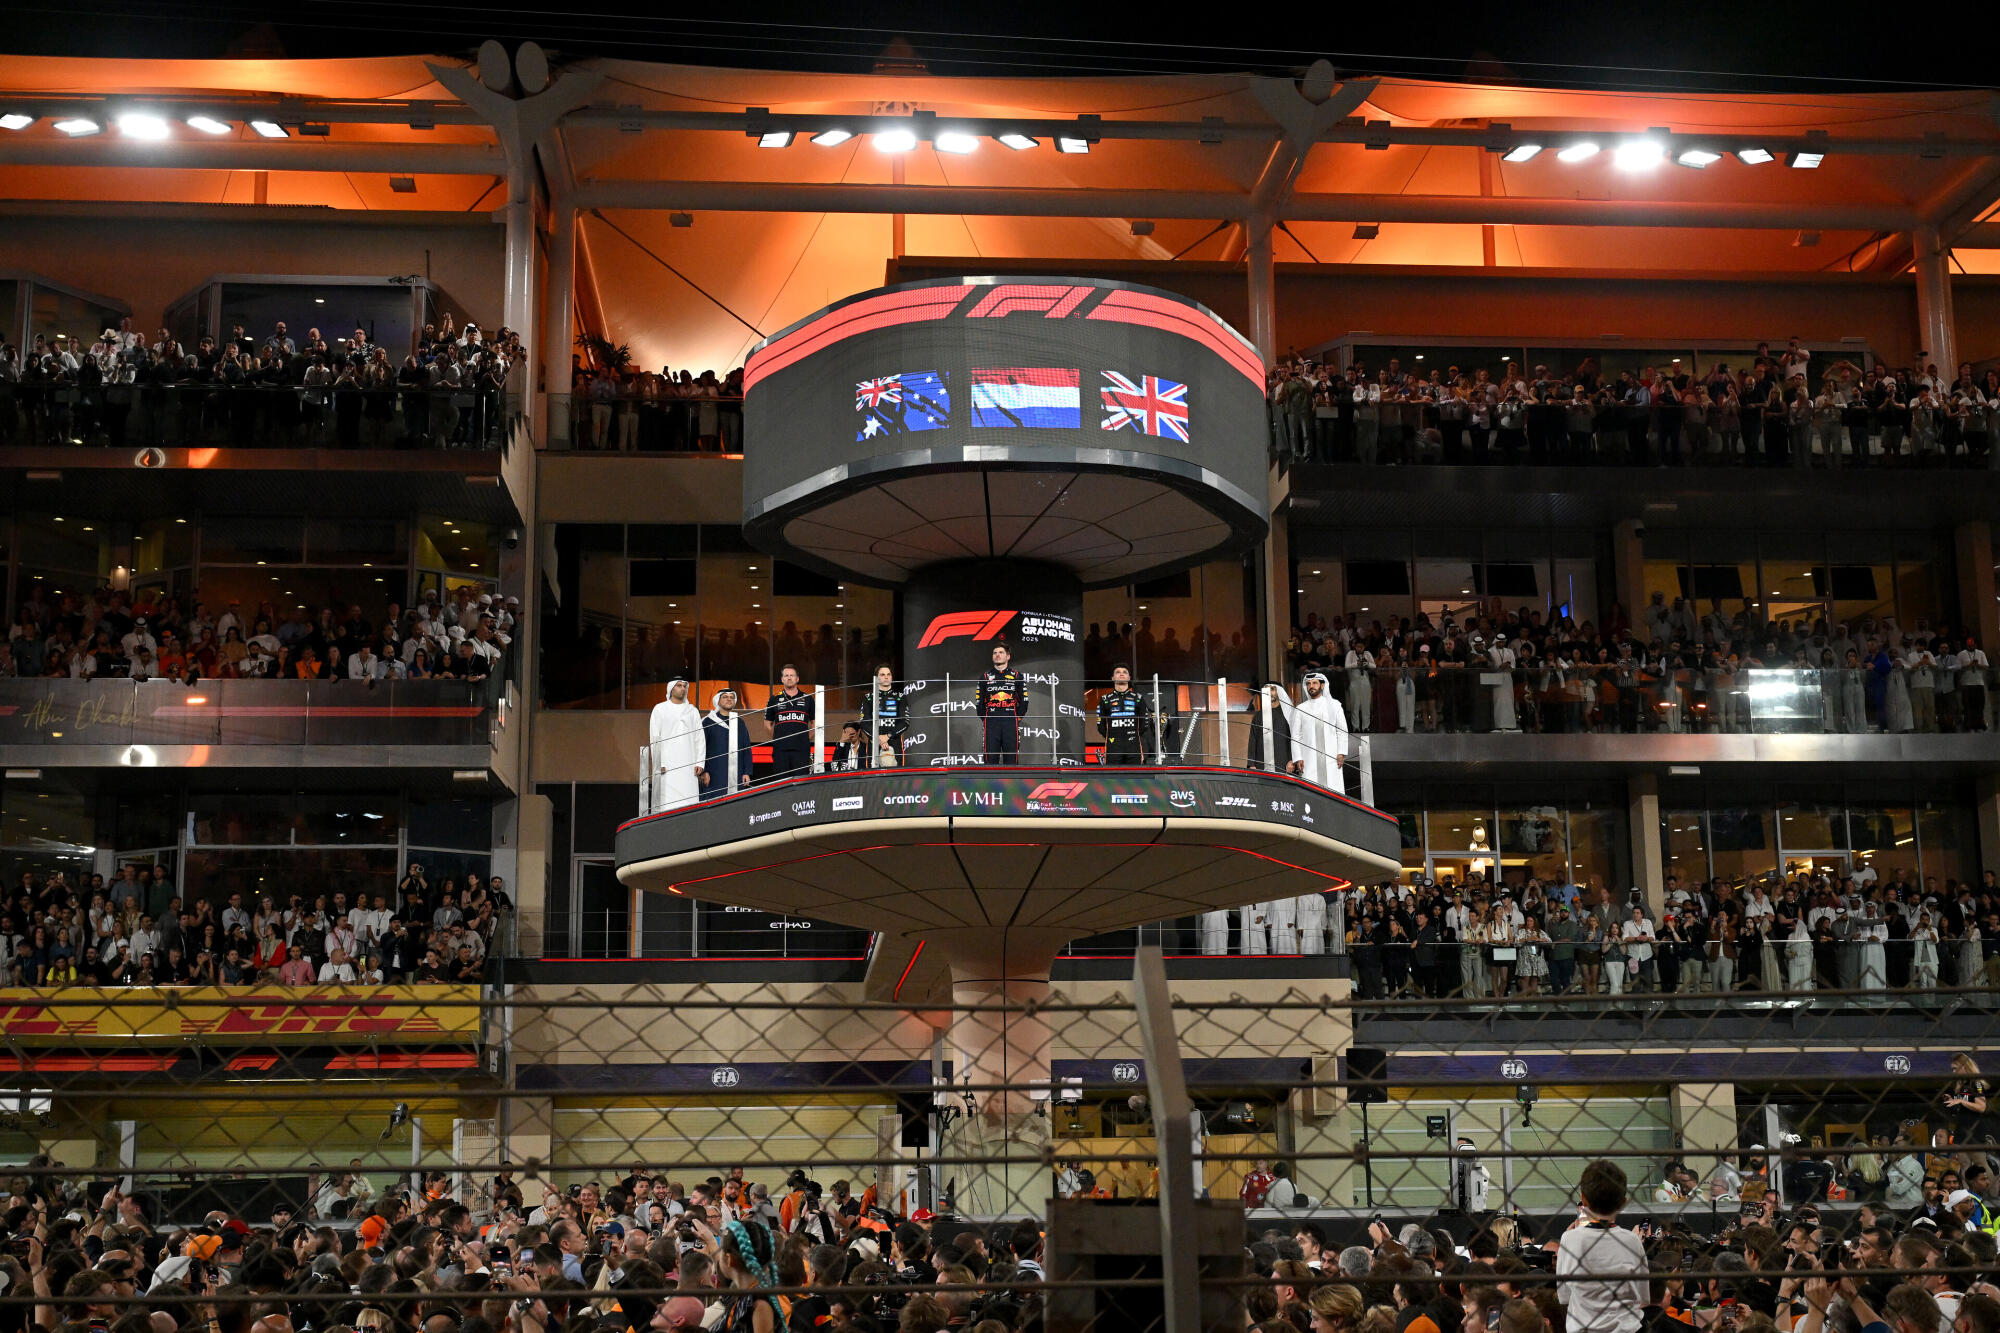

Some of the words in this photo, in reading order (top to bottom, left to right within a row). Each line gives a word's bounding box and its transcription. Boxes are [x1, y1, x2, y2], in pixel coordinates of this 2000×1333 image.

[1022, 617, 1045, 627] ABU
[1045, 619, 1071, 632] DHABI
[1021, 626, 1058, 638] GRAND
[1058, 630, 1075, 642] PRIX
[22, 692, 67, 730] Abu
[74, 694, 141, 730] Dhabi
[930, 701, 976, 714] ETIHA
[778, 713, 791, 722] Red
[791, 712, 805, 721] Bull
[878, 719, 895, 727] KX
[1111, 718, 1135, 728] OKX
[883, 794, 929, 805] aramco
[952, 792, 1004, 805] LVMH
[1111, 794, 1148, 804] PIRELLI
[1170, 790, 1195, 801] aws
[792, 800, 816, 811] QATAR
[835, 800, 860, 808] Lenovo
[1221, 796, 1251, 807] DHL
[1280, 801, 1295, 813] MSC
[755, 810, 782, 822] crypto.com
[216, 995, 405, 1033] DHL
